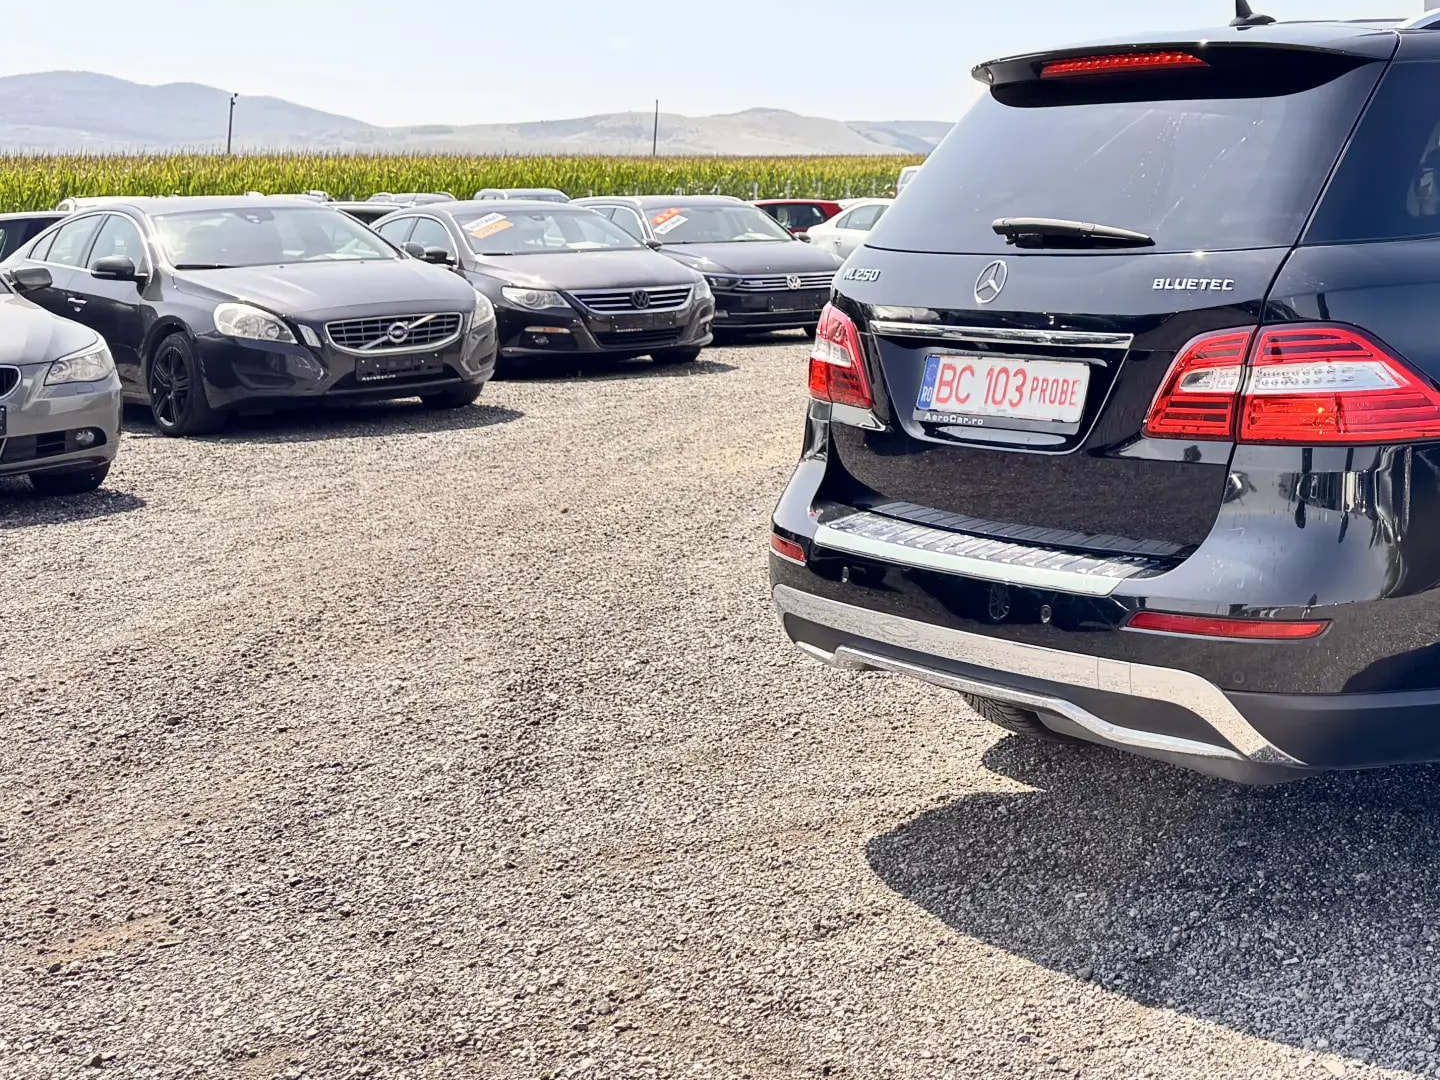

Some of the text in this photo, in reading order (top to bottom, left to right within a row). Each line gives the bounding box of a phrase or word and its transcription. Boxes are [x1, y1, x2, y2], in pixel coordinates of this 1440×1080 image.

[1152, 278, 1235, 291] BLUETEC
[935, 363, 1080, 408] BC 103 PROBE
[920, 386, 934, 402] RO
[923, 412, 984, 426] AeroCar.ro
